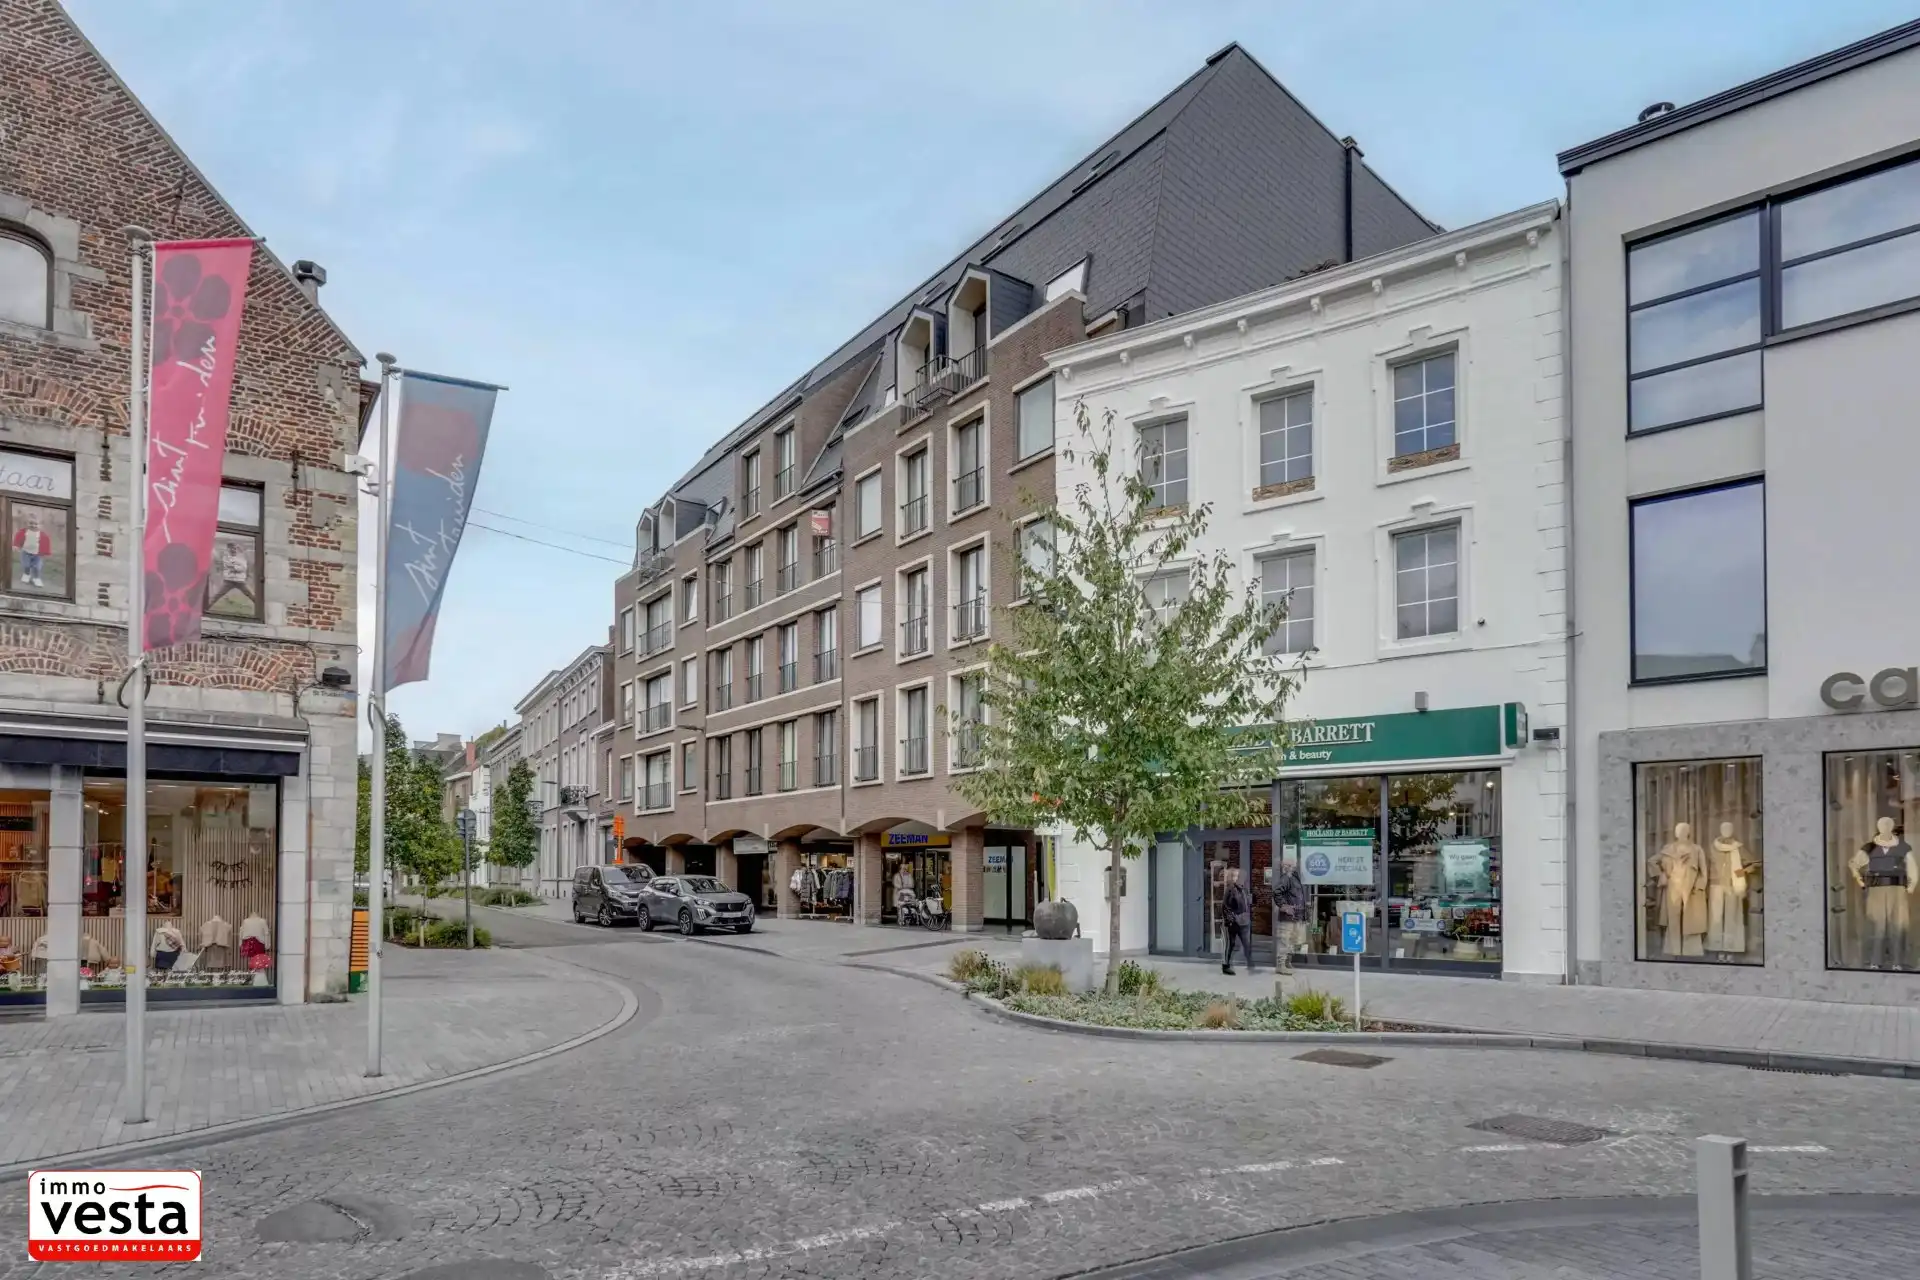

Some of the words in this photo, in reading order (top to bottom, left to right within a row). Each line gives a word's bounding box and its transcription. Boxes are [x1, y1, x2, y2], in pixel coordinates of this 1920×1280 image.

[1291, 722, 1375, 743] BARRETT
[1300, 750, 1332, 761] beauty
[888, 833, 928, 845] ZEEMAN
